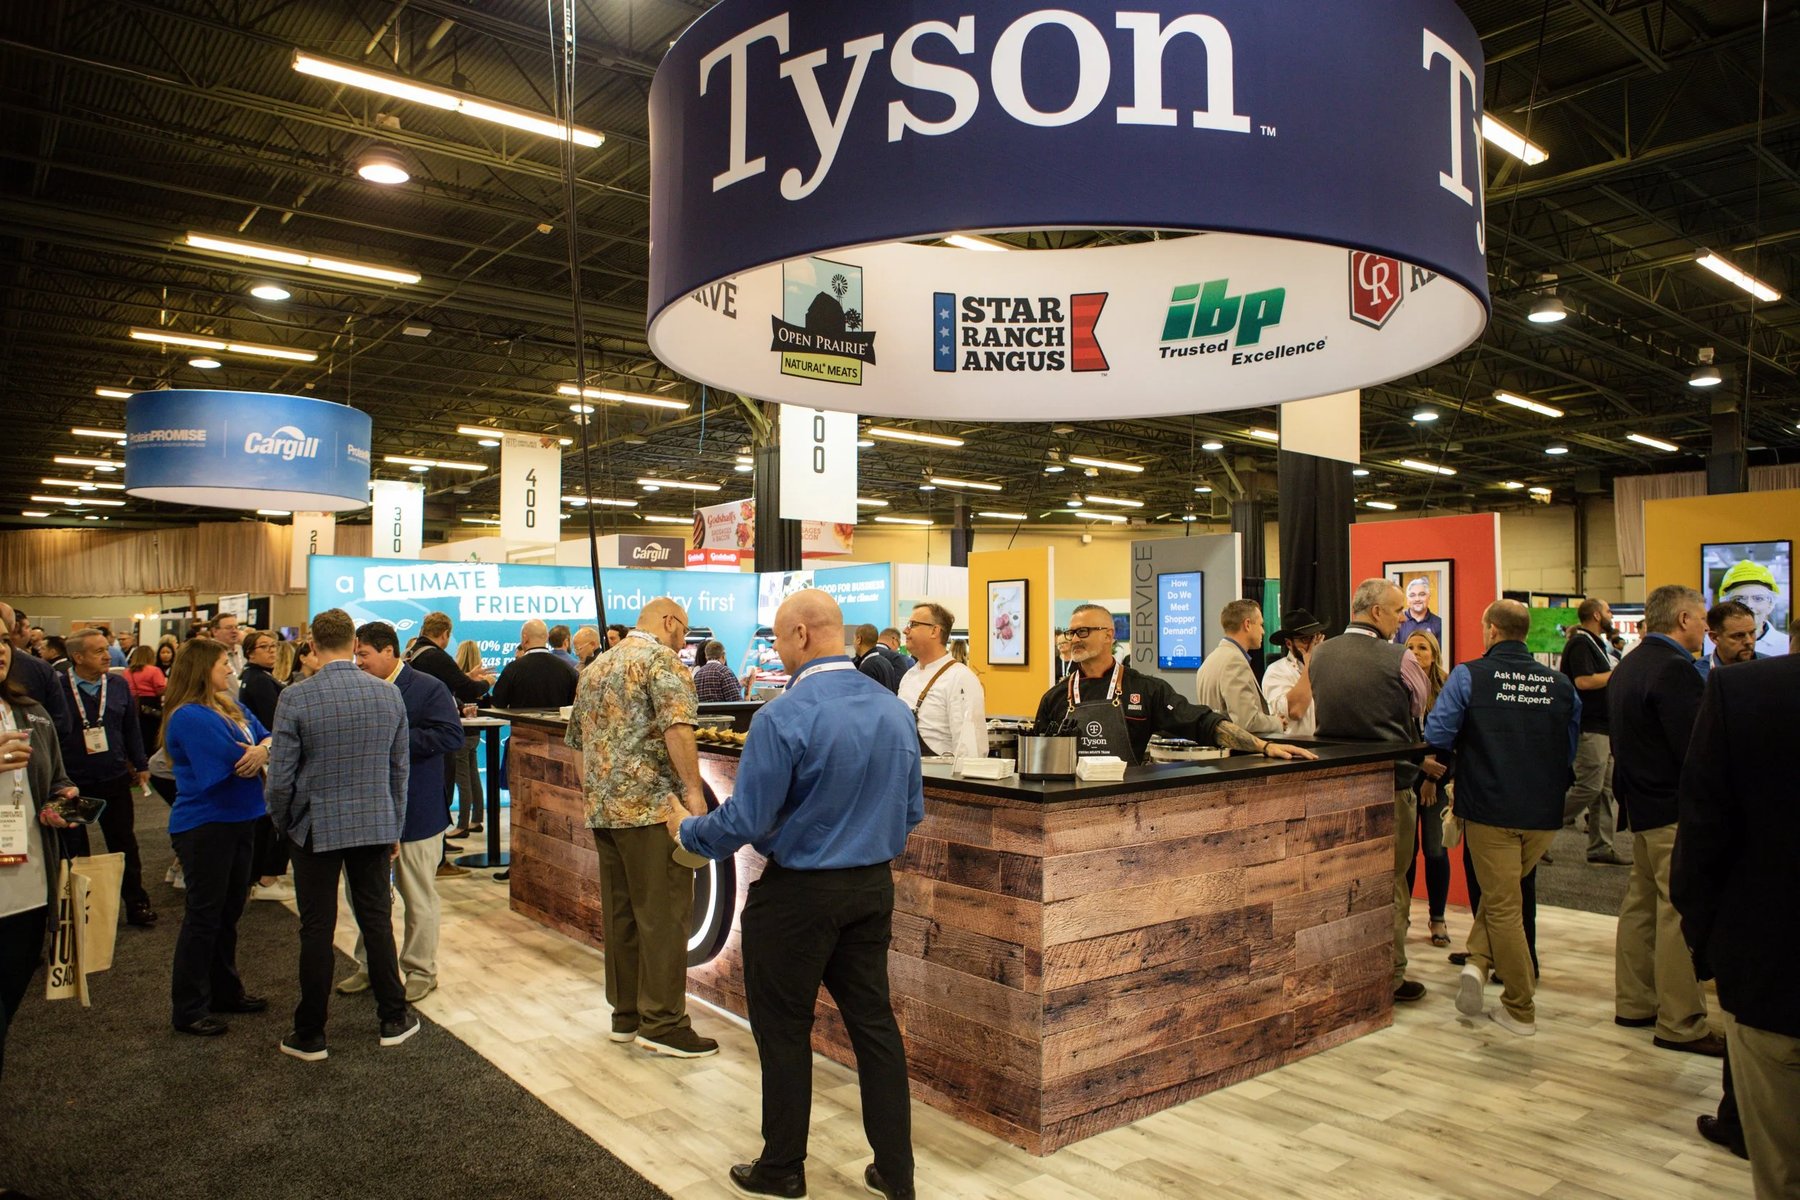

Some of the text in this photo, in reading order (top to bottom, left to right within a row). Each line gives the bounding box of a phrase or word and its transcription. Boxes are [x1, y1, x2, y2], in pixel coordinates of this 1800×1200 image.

[700, 9, 1251, 201] Tyson
[961, 295, 1065, 324] STAR
[1160, 277, 1287, 347] ibp
[778, 327, 866, 356] OPEN PRAIRIE
[961, 326, 1065, 348] RANCH
[1158, 339, 1229, 359] Trusted
[1231, 338, 1327, 366] Excellence
[784, 357, 858, 379] NATURAL MEATS
[961, 350, 1066, 372] ANGUS
[243, 428, 320, 461] Cargill
[525, 467, 537, 529] 400
[393, 506, 402, 554] 300
[632, 545, 671, 563] Cargill
[335, 570, 487, 594] a CLIMATE
[1170, 579, 1188, 588] How
[475, 595, 585, 614] FRIENDLY
[697, 589, 736, 613] first
[1135, 545, 1154, 663] SERVICE
[1167, 591, 1192, 600] Do We
[1170, 602, 1189, 612] Meet
[1162, 626, 1198, 636] Demand?
[1164, 615, 1196, 625] Shopper
[482, 657, 501, 669] gas
[1493, 670, 1555, 684] Ask Me About
[1502, 682, 1547, 693] the Beef &
[1495, 692, 1552, 705] Pork Experts
[1080, 736, 1108, 747] Tyson
